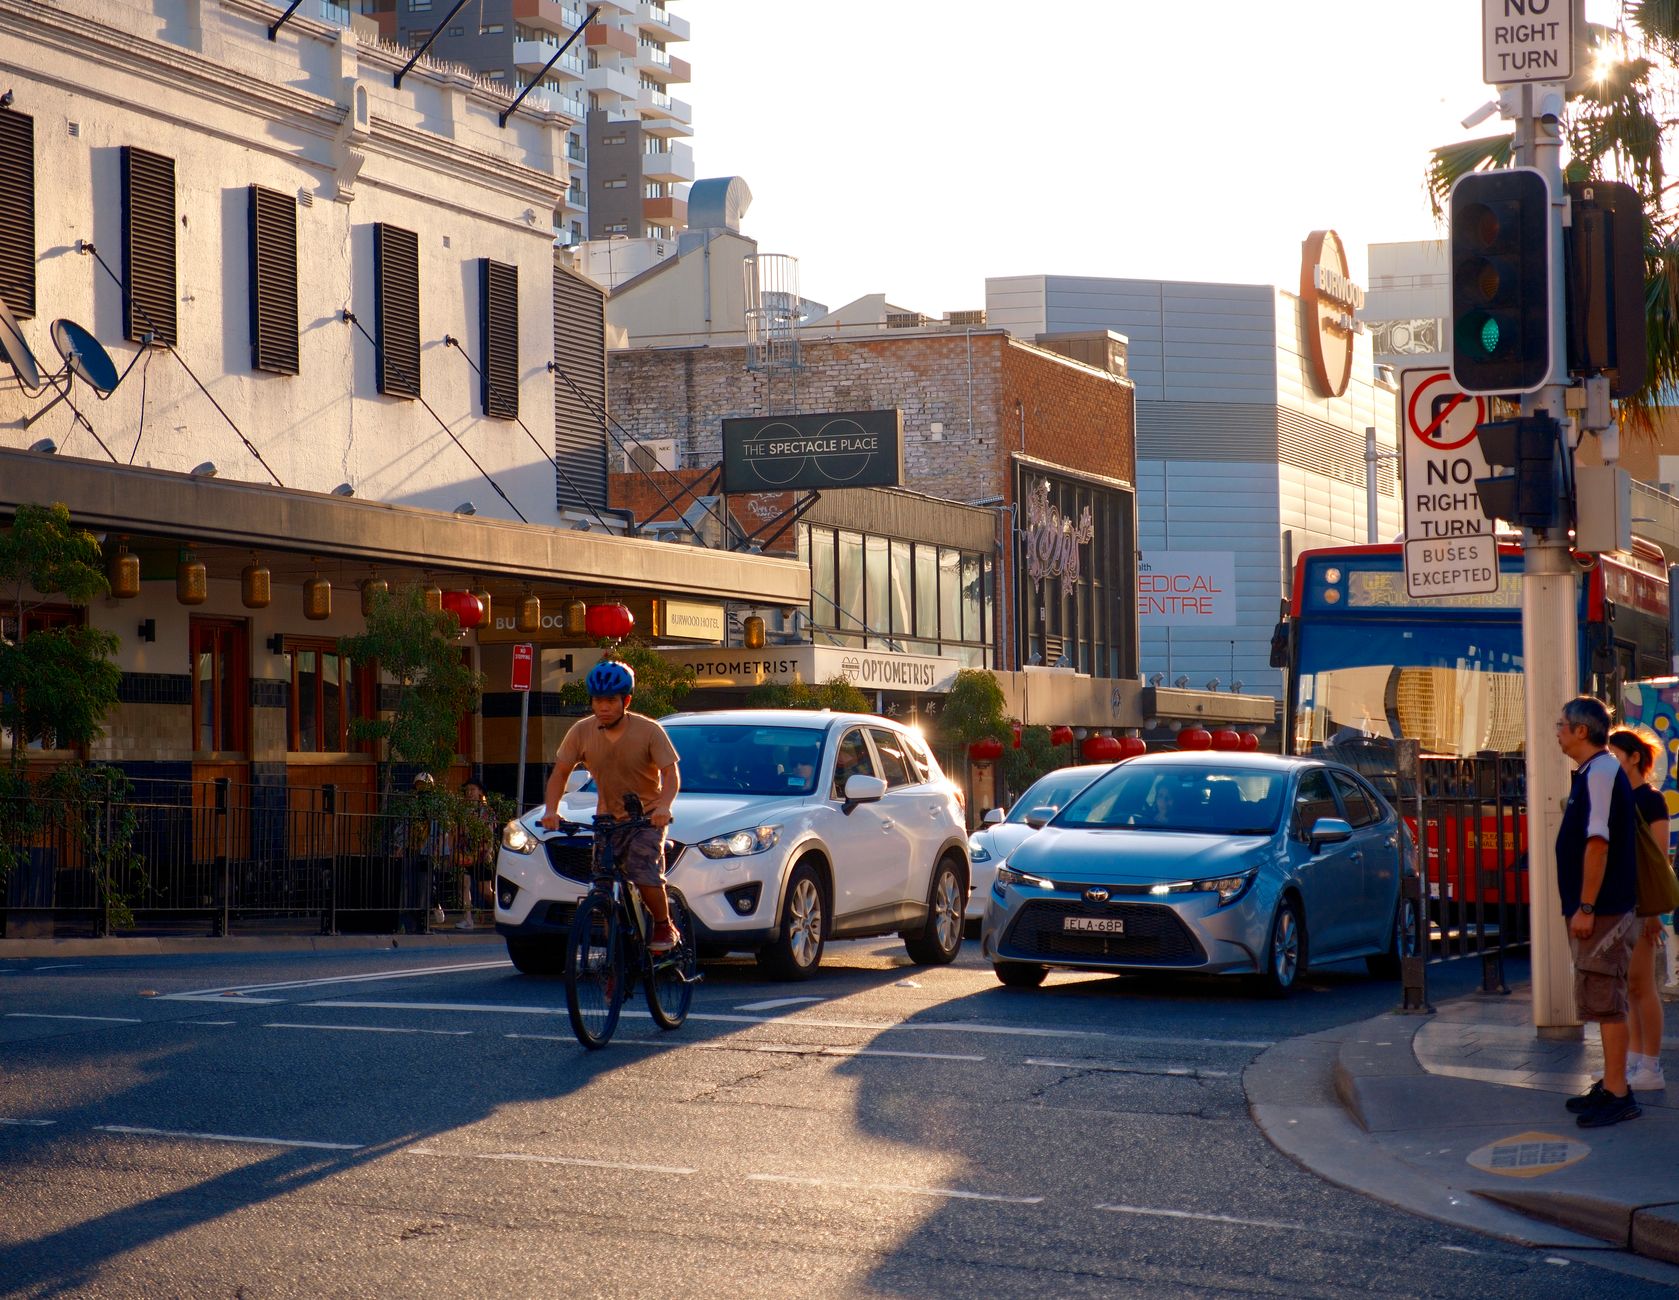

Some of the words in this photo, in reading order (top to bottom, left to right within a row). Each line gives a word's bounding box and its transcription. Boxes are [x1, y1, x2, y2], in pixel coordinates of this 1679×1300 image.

[1504, 0, 1550, 17] NO
[1495, 22, 1560, 44] RIGHT
[1498, 49, 1558, 71] TURN
[743, 444, 766, 456] THE
[769, 440, 837, 455] SPECTACLE
[840, 437, 878, 451] PLACE
[1427, 458, 1473, 485] NO
[1417, 493, 1480, 512] RIGHT
[1421, 519, 1481, 537] TURN
[1423, 546, 1479, 563] BUSES
[1138, 563, 1152, 571] alth
[1138, 575, 1222, 592] EDICAL
[1412, 567, 1492, 586] EXCEPTED
[1138, 596, 1213, 614] ENTRE
[672, 614, 699, 627] BURWOOD
[701, 616, 719, 629] HOTEL
[862, 659, 935, 685] OPTOMETRIST
